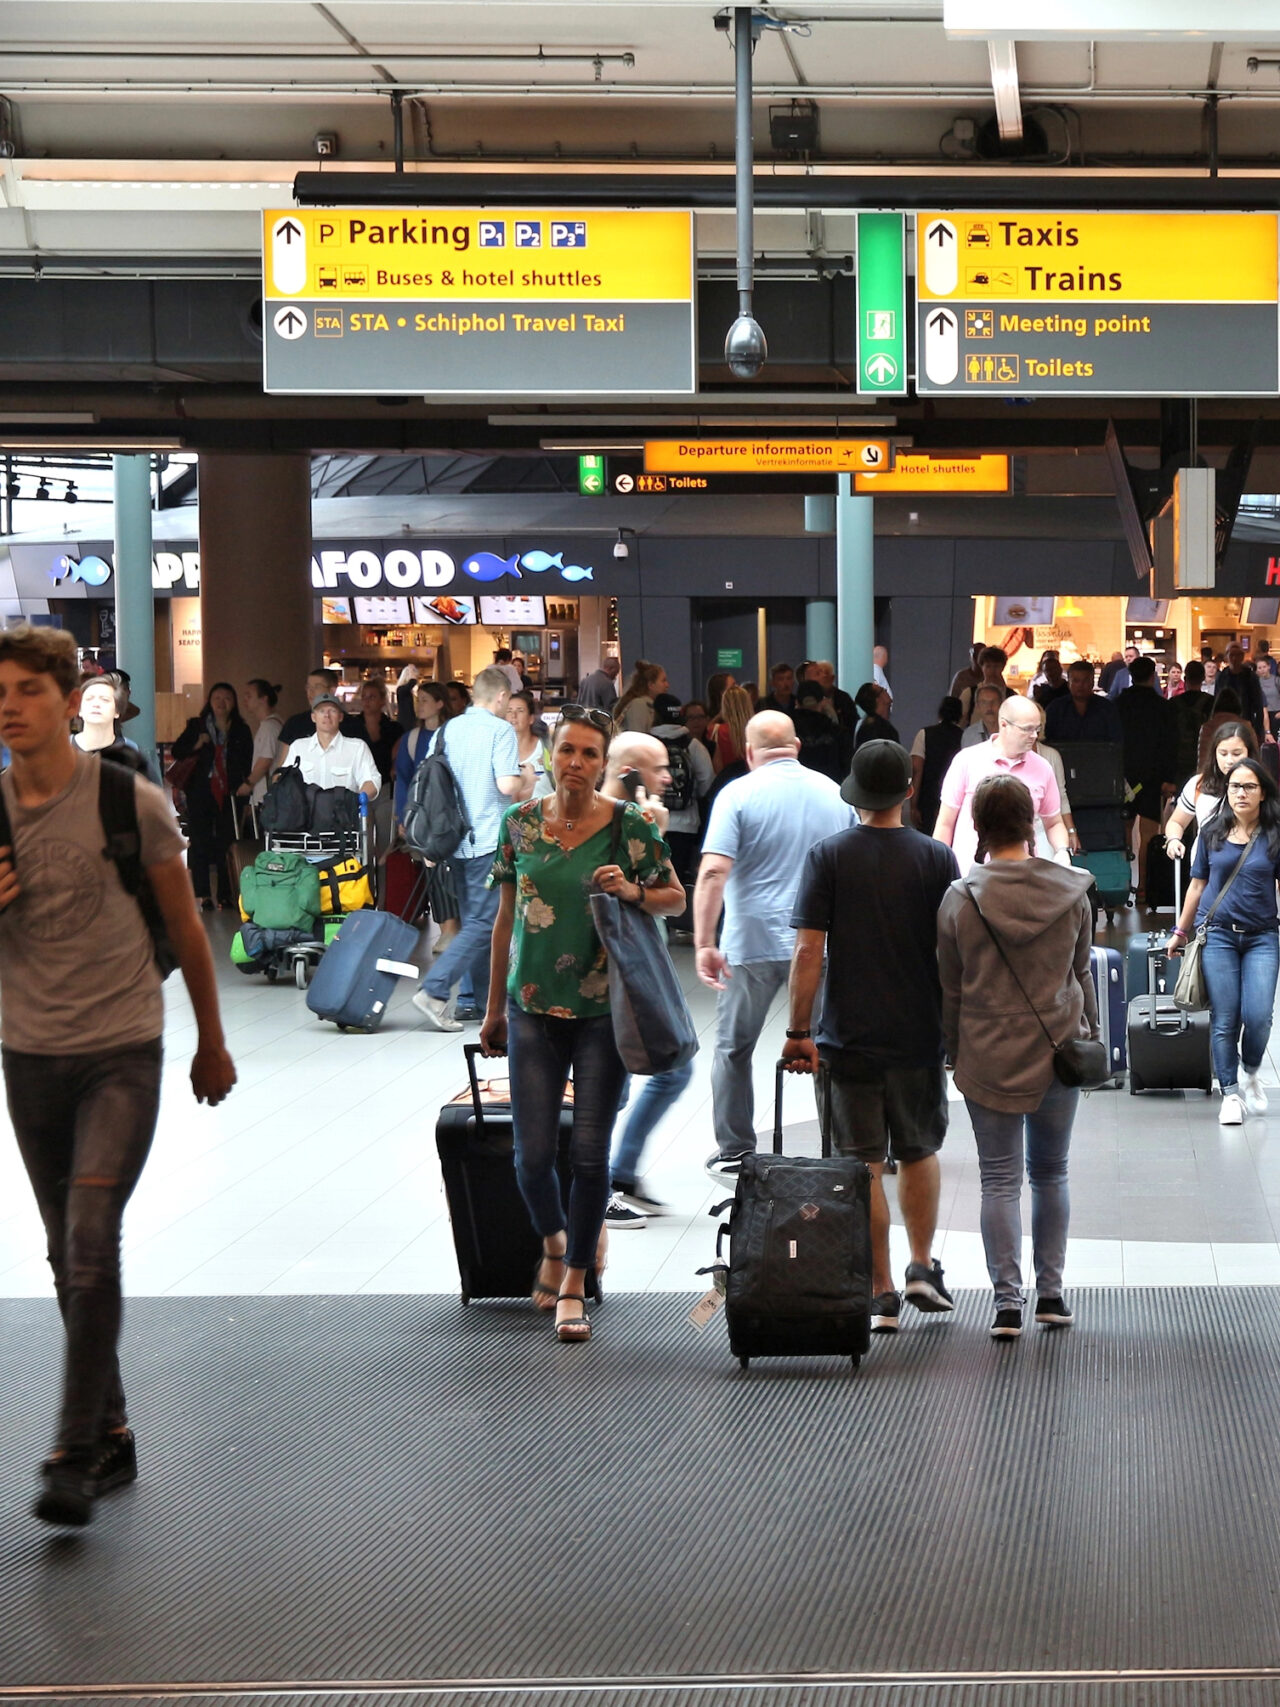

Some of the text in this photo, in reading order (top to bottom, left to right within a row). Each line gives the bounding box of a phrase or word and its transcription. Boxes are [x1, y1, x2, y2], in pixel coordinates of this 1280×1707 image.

[320, 219, 576, 250] P Parking P1 P2 P3
[999, 221, 1079, 247] Taxis
[377, 270, 601, 286] Buses & hotel shuttles
[1024, 266, 1122, 291] Trains
[316, 313, 625, 335] STA STA Schiphol Travel Taxi
[1000, 314, 1150, 336] Meeting point
[1025, 359, 1094, 377] Toilets
[678, 443, 833, 458] Departure information
[756, 458, 833, 467] Vertrekinformatie
[900, 464, 976, 473] Hotel shuttles
[669, 477, 708, 488] Toilets
